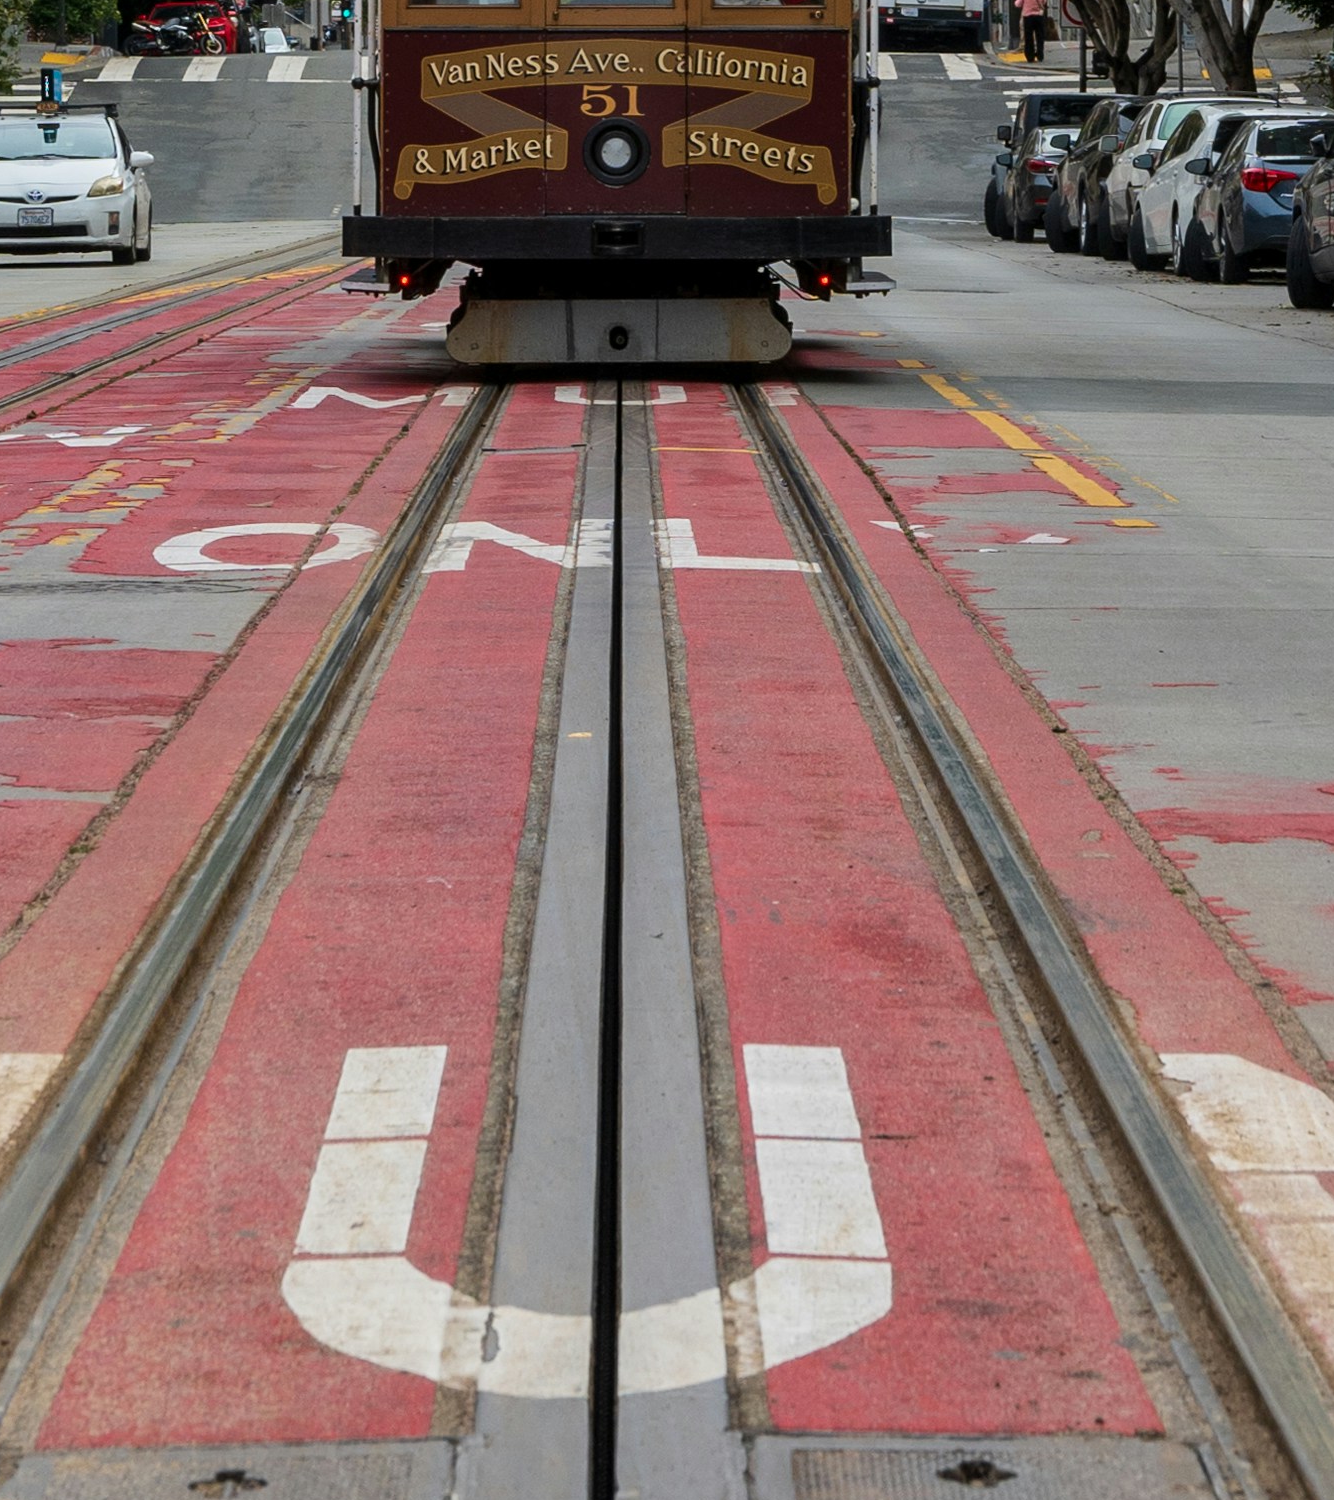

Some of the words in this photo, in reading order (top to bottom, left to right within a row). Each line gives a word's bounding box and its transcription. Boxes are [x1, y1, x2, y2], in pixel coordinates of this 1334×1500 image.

[429, 57, 481, 87] Van
[485, 52, 560, 80] Ness
[657, 47, 808, 88] California
[580, 84, 646, 118] 51
[415, 148, 437, 174] &
[445, 133, 554, 175] Market
[688, 130, 816, 174] Streets
